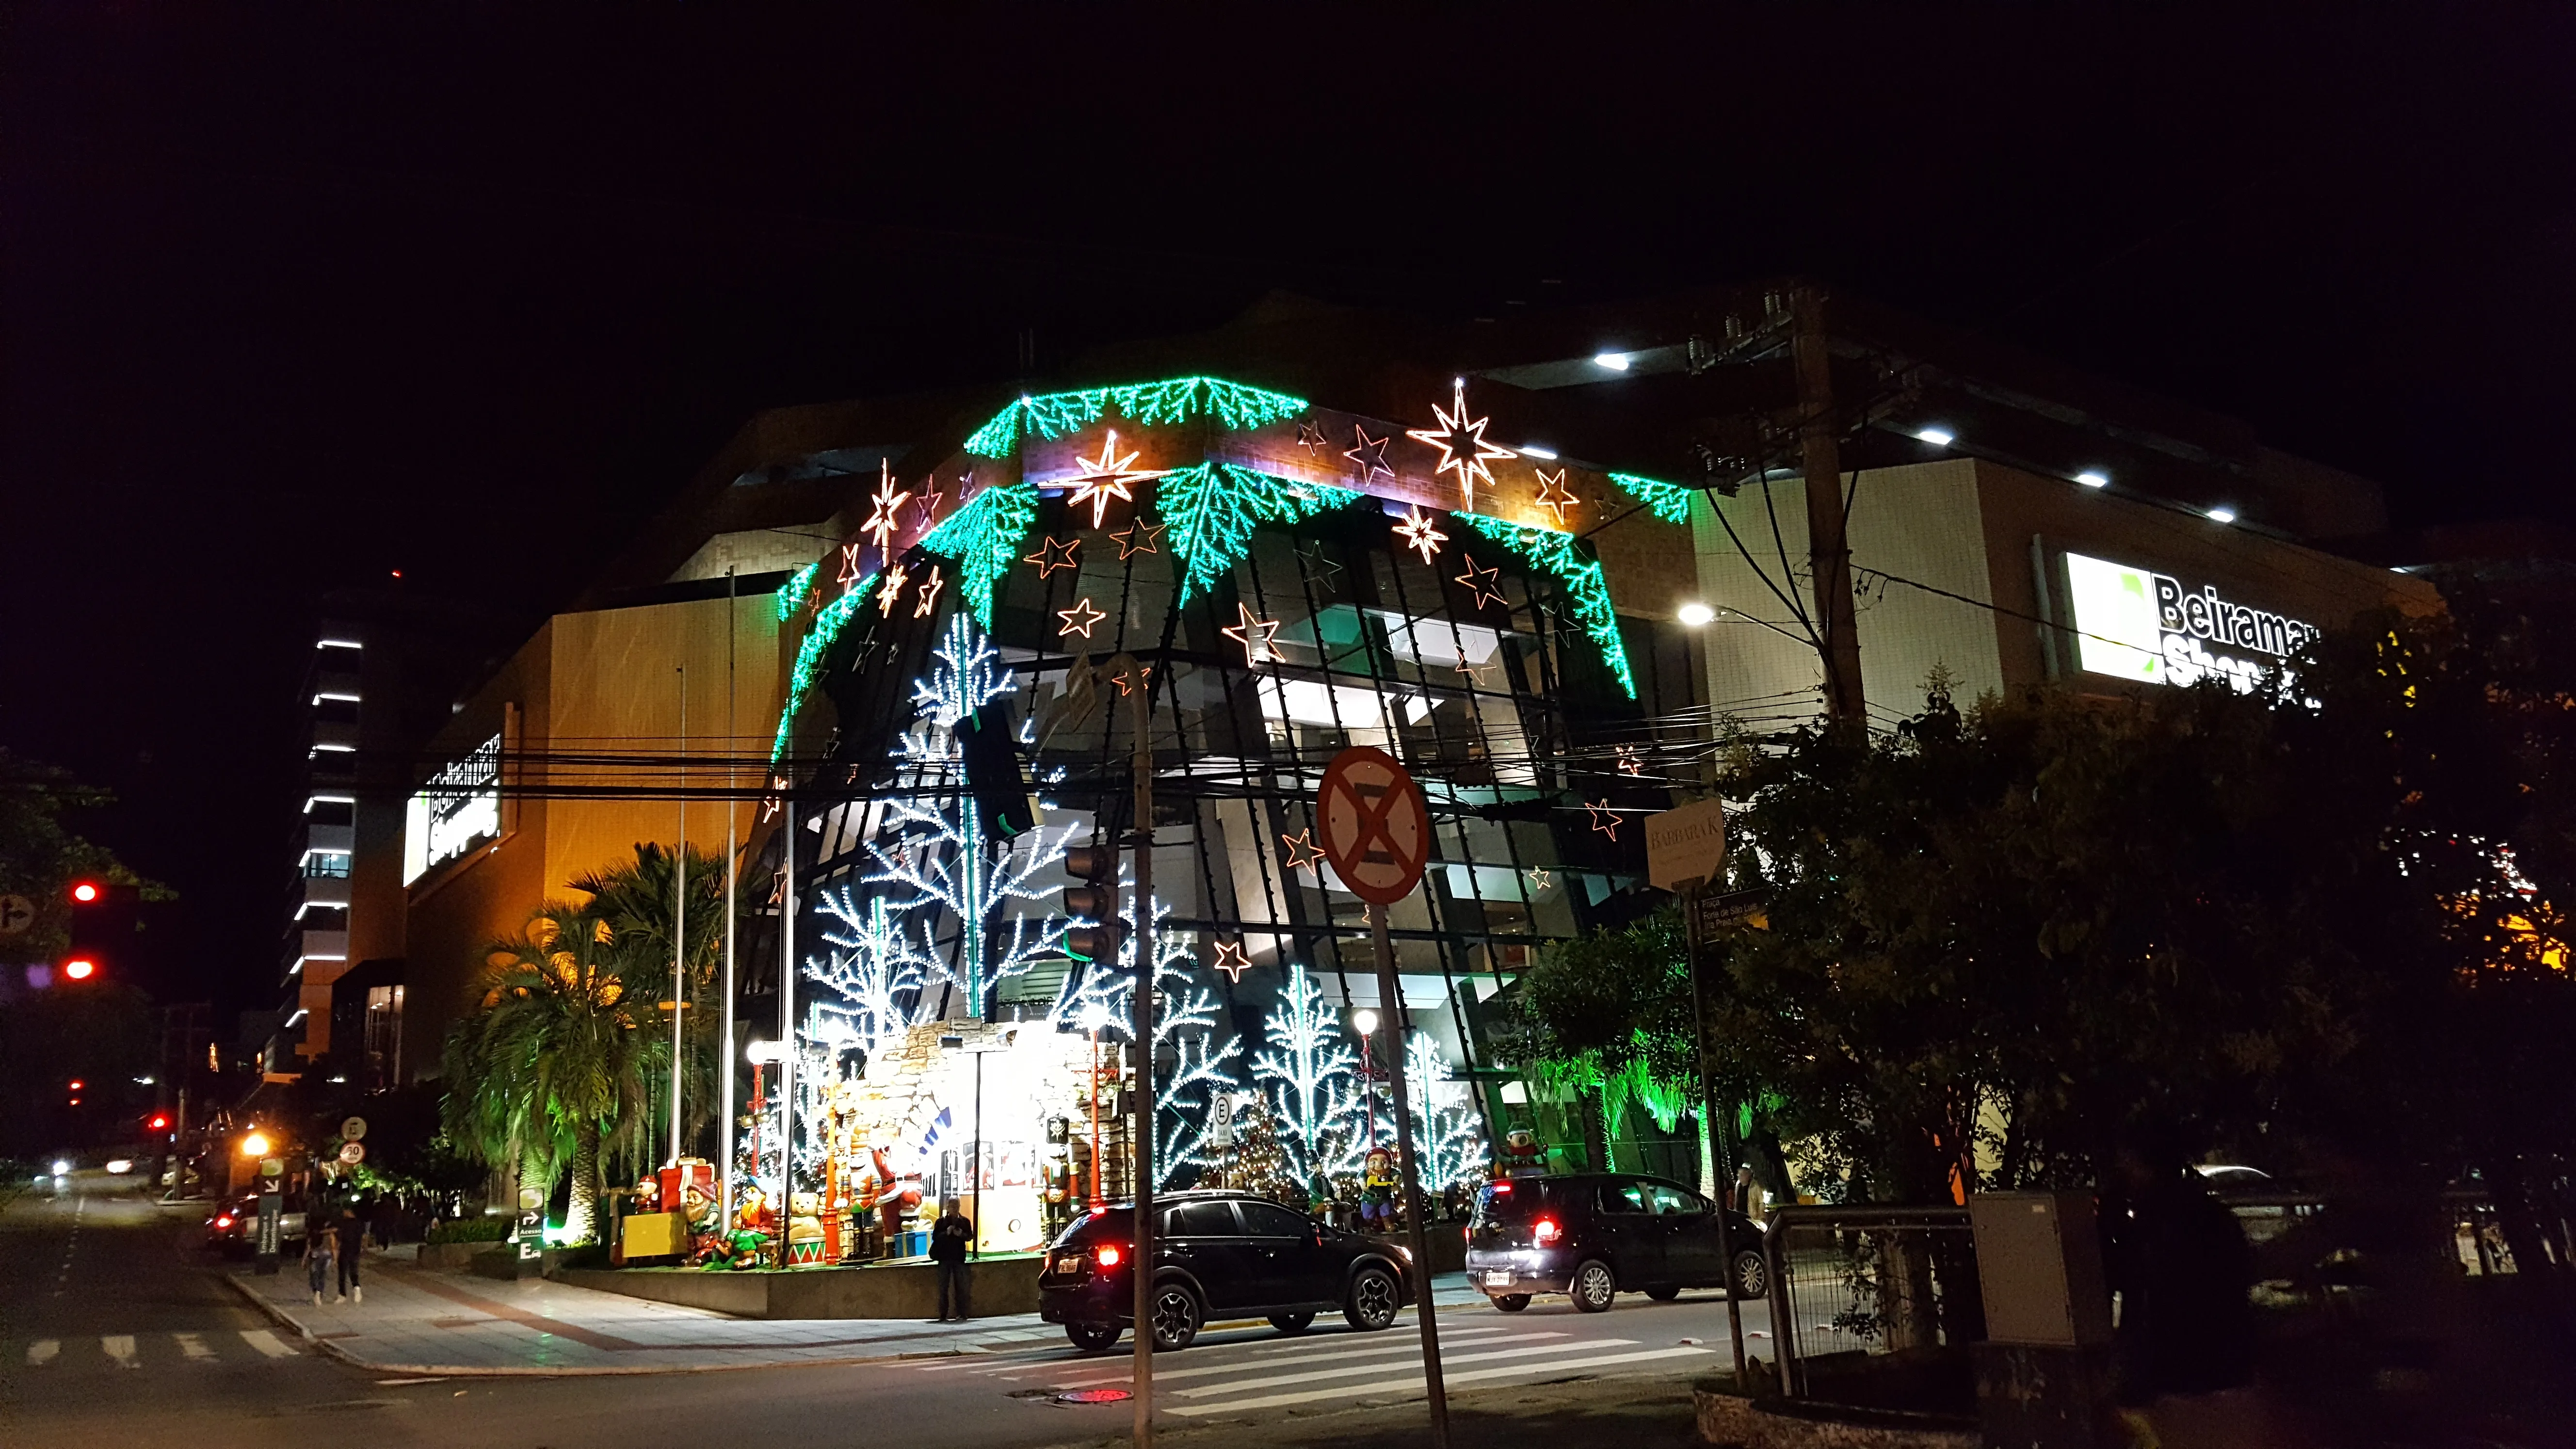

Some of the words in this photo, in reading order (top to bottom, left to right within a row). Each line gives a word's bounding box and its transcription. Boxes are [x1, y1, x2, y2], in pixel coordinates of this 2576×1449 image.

[1702, 899, 1721, 909] Praça
[1219, 1104, 1225, 1118] E
[520, 1242, 531, 1259] E
